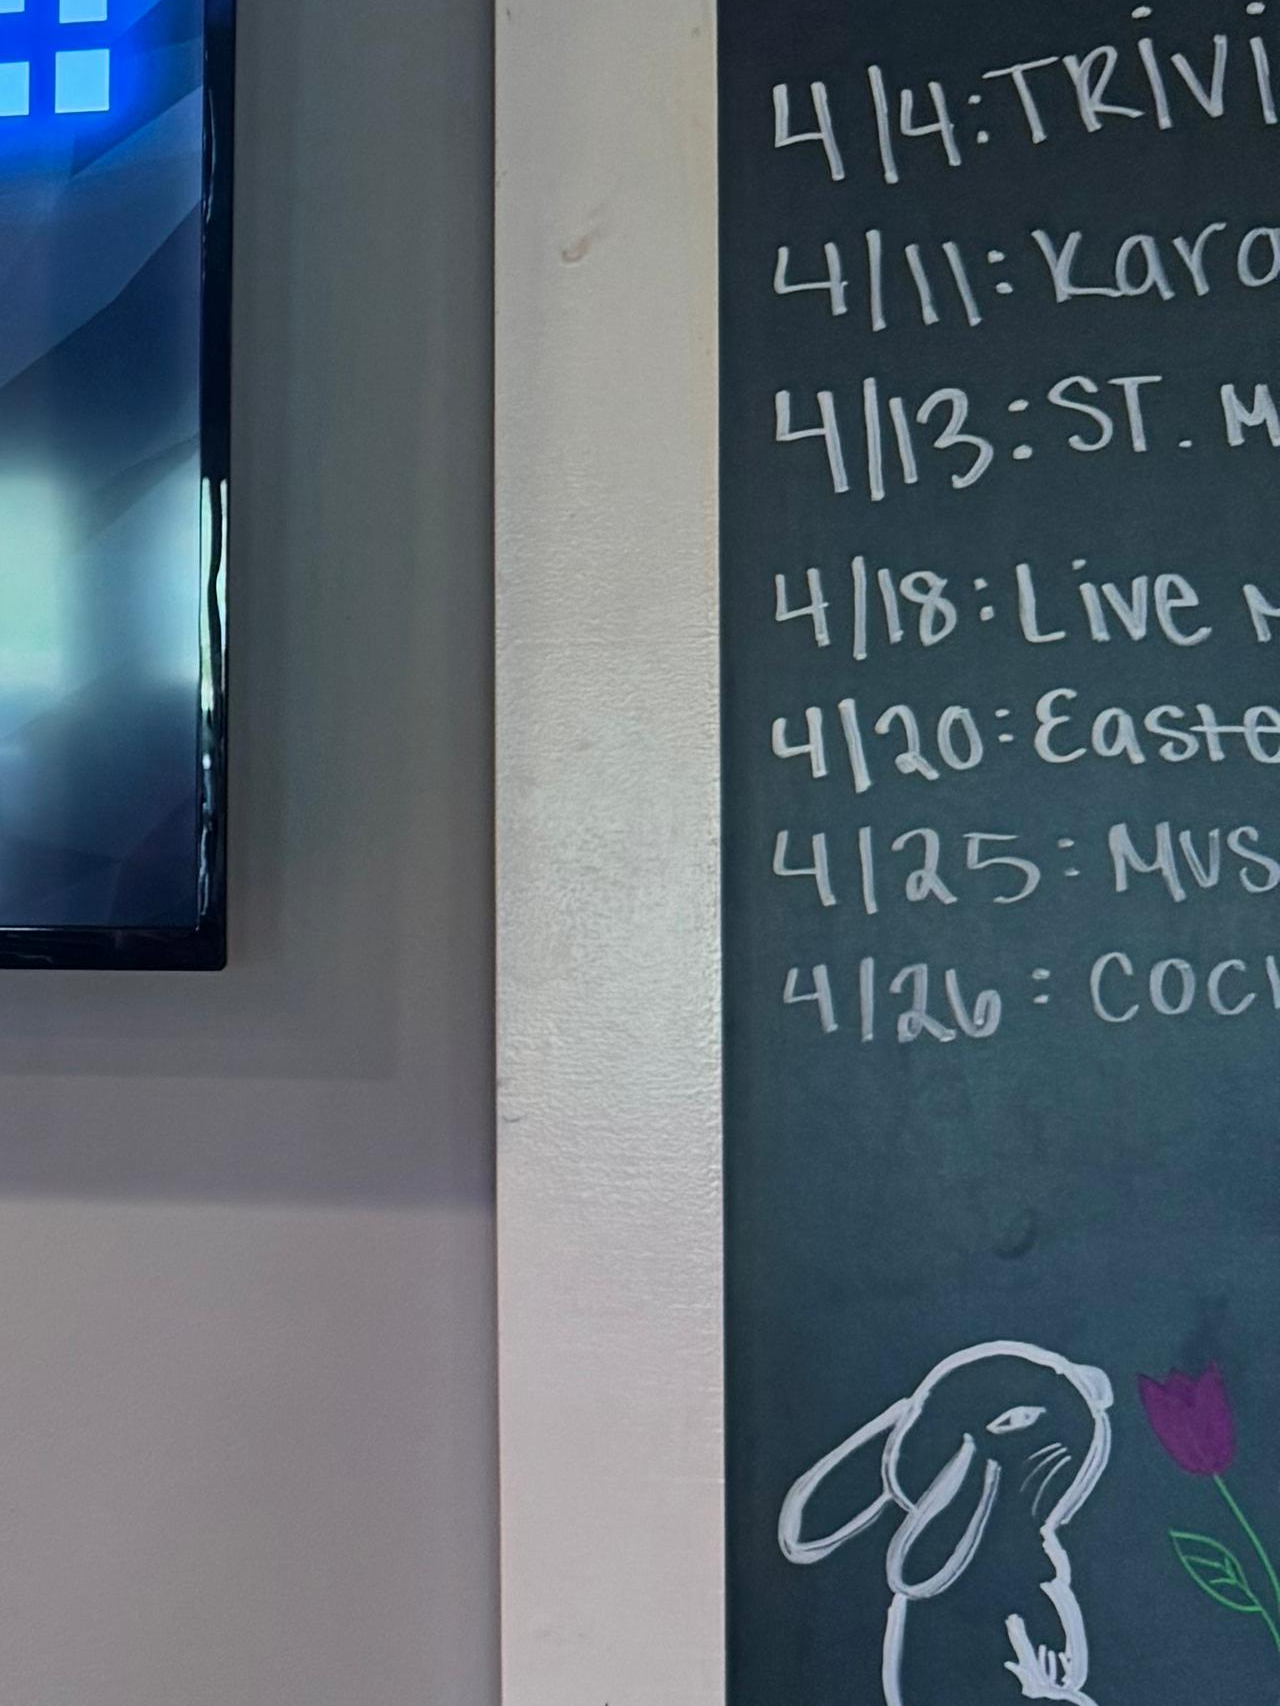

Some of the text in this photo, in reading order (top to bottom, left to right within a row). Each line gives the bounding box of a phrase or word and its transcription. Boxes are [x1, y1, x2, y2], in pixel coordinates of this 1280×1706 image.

[772, 64, 989, 185] 4/4:
[773, 228, 1013, 332] 4/11:
[775, 376, 1033, 502] 4/13:
[1047, 375, 1192, 453] ST.
[774, 555, 994, 661] 4/18:
[1015, 558, 1213, 646] Live
[771, 697, 1015, 794] 4/20:
[773, 826, 1081, 915] 4/25:
[783, 956, 1051, 1043] 4/26:
